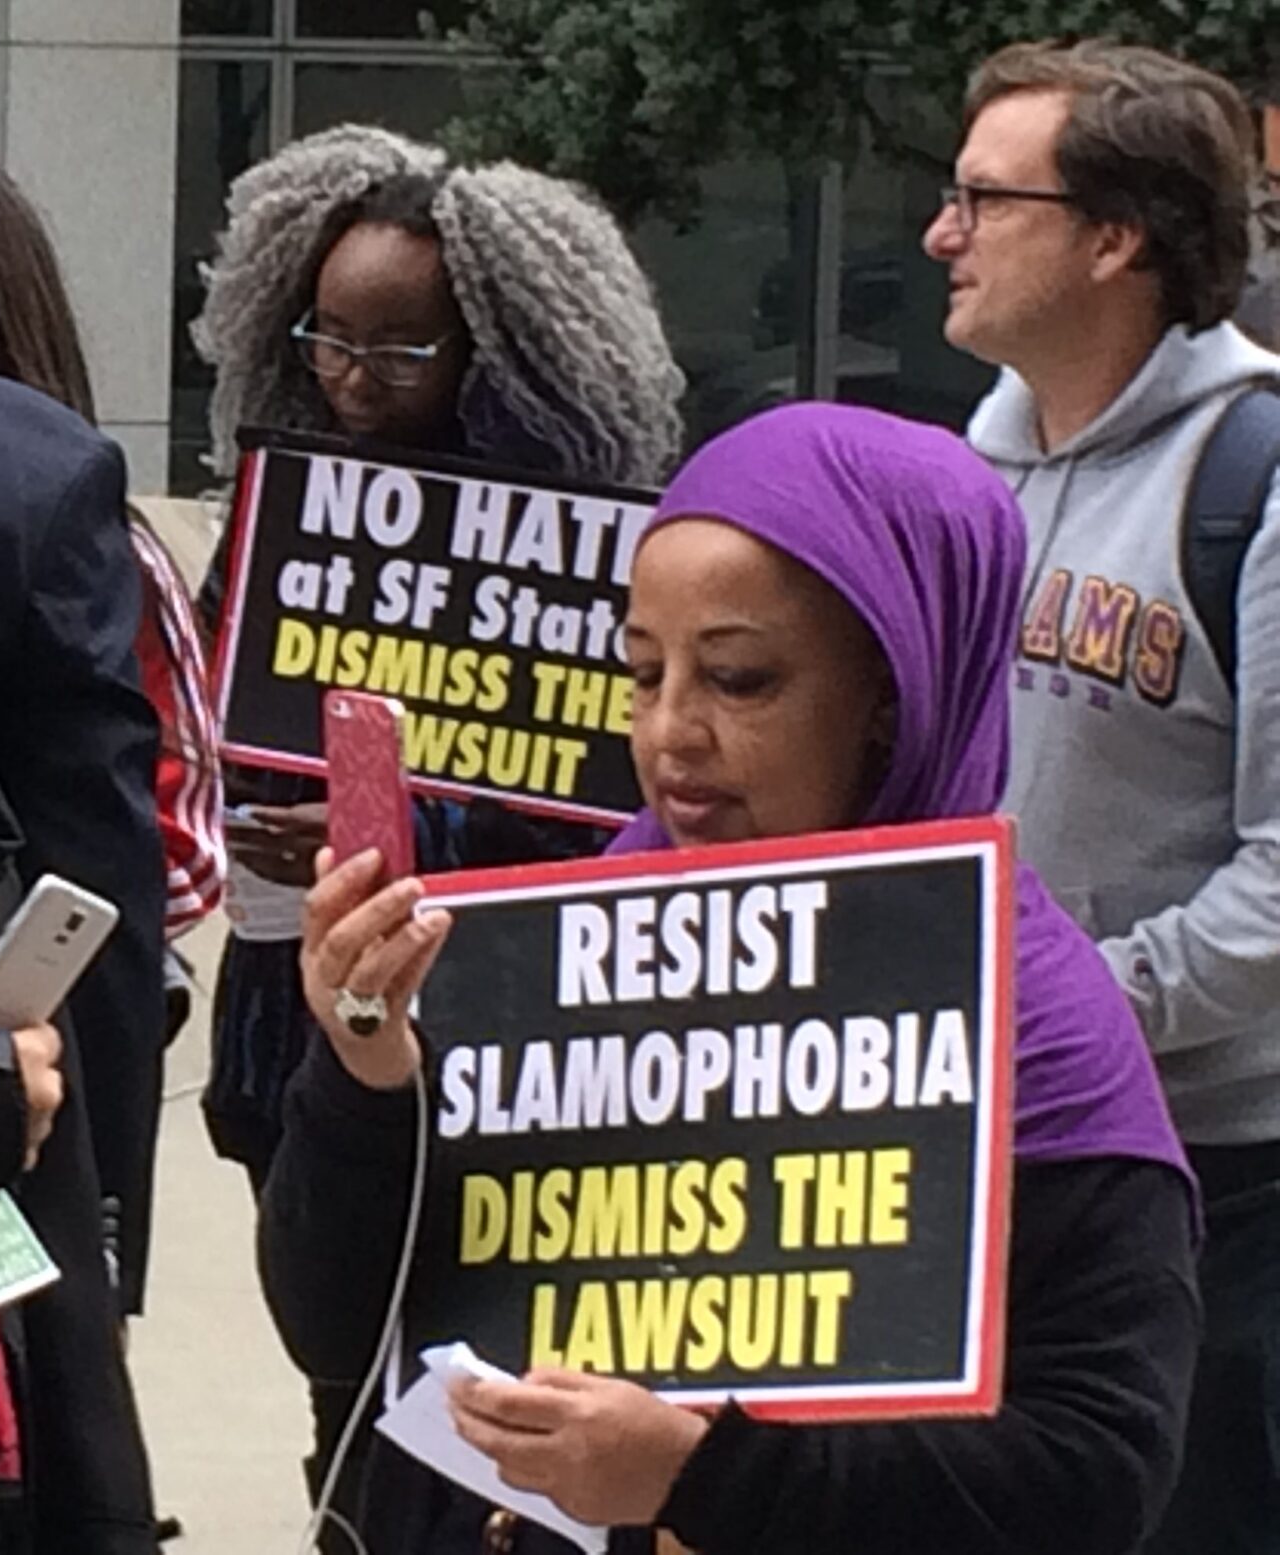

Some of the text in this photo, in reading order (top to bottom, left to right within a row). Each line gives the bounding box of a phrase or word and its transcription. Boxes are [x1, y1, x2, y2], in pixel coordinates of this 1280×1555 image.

[299, 455, 423, 548] NO
[277, 554, 354, 616] at
[372, 558, 451, 630] SF
[1021, 568, 1187, 710] AMS
[272, 618, 635, 736] DISMISS THE
[404, 711, 588, 797] WSUIT
[557, 880, 828, 1008] RESIST
[458, 1148, 912, 1265] DISMISS THE
[530, 1270, 852, 1375] LAWSUIT
